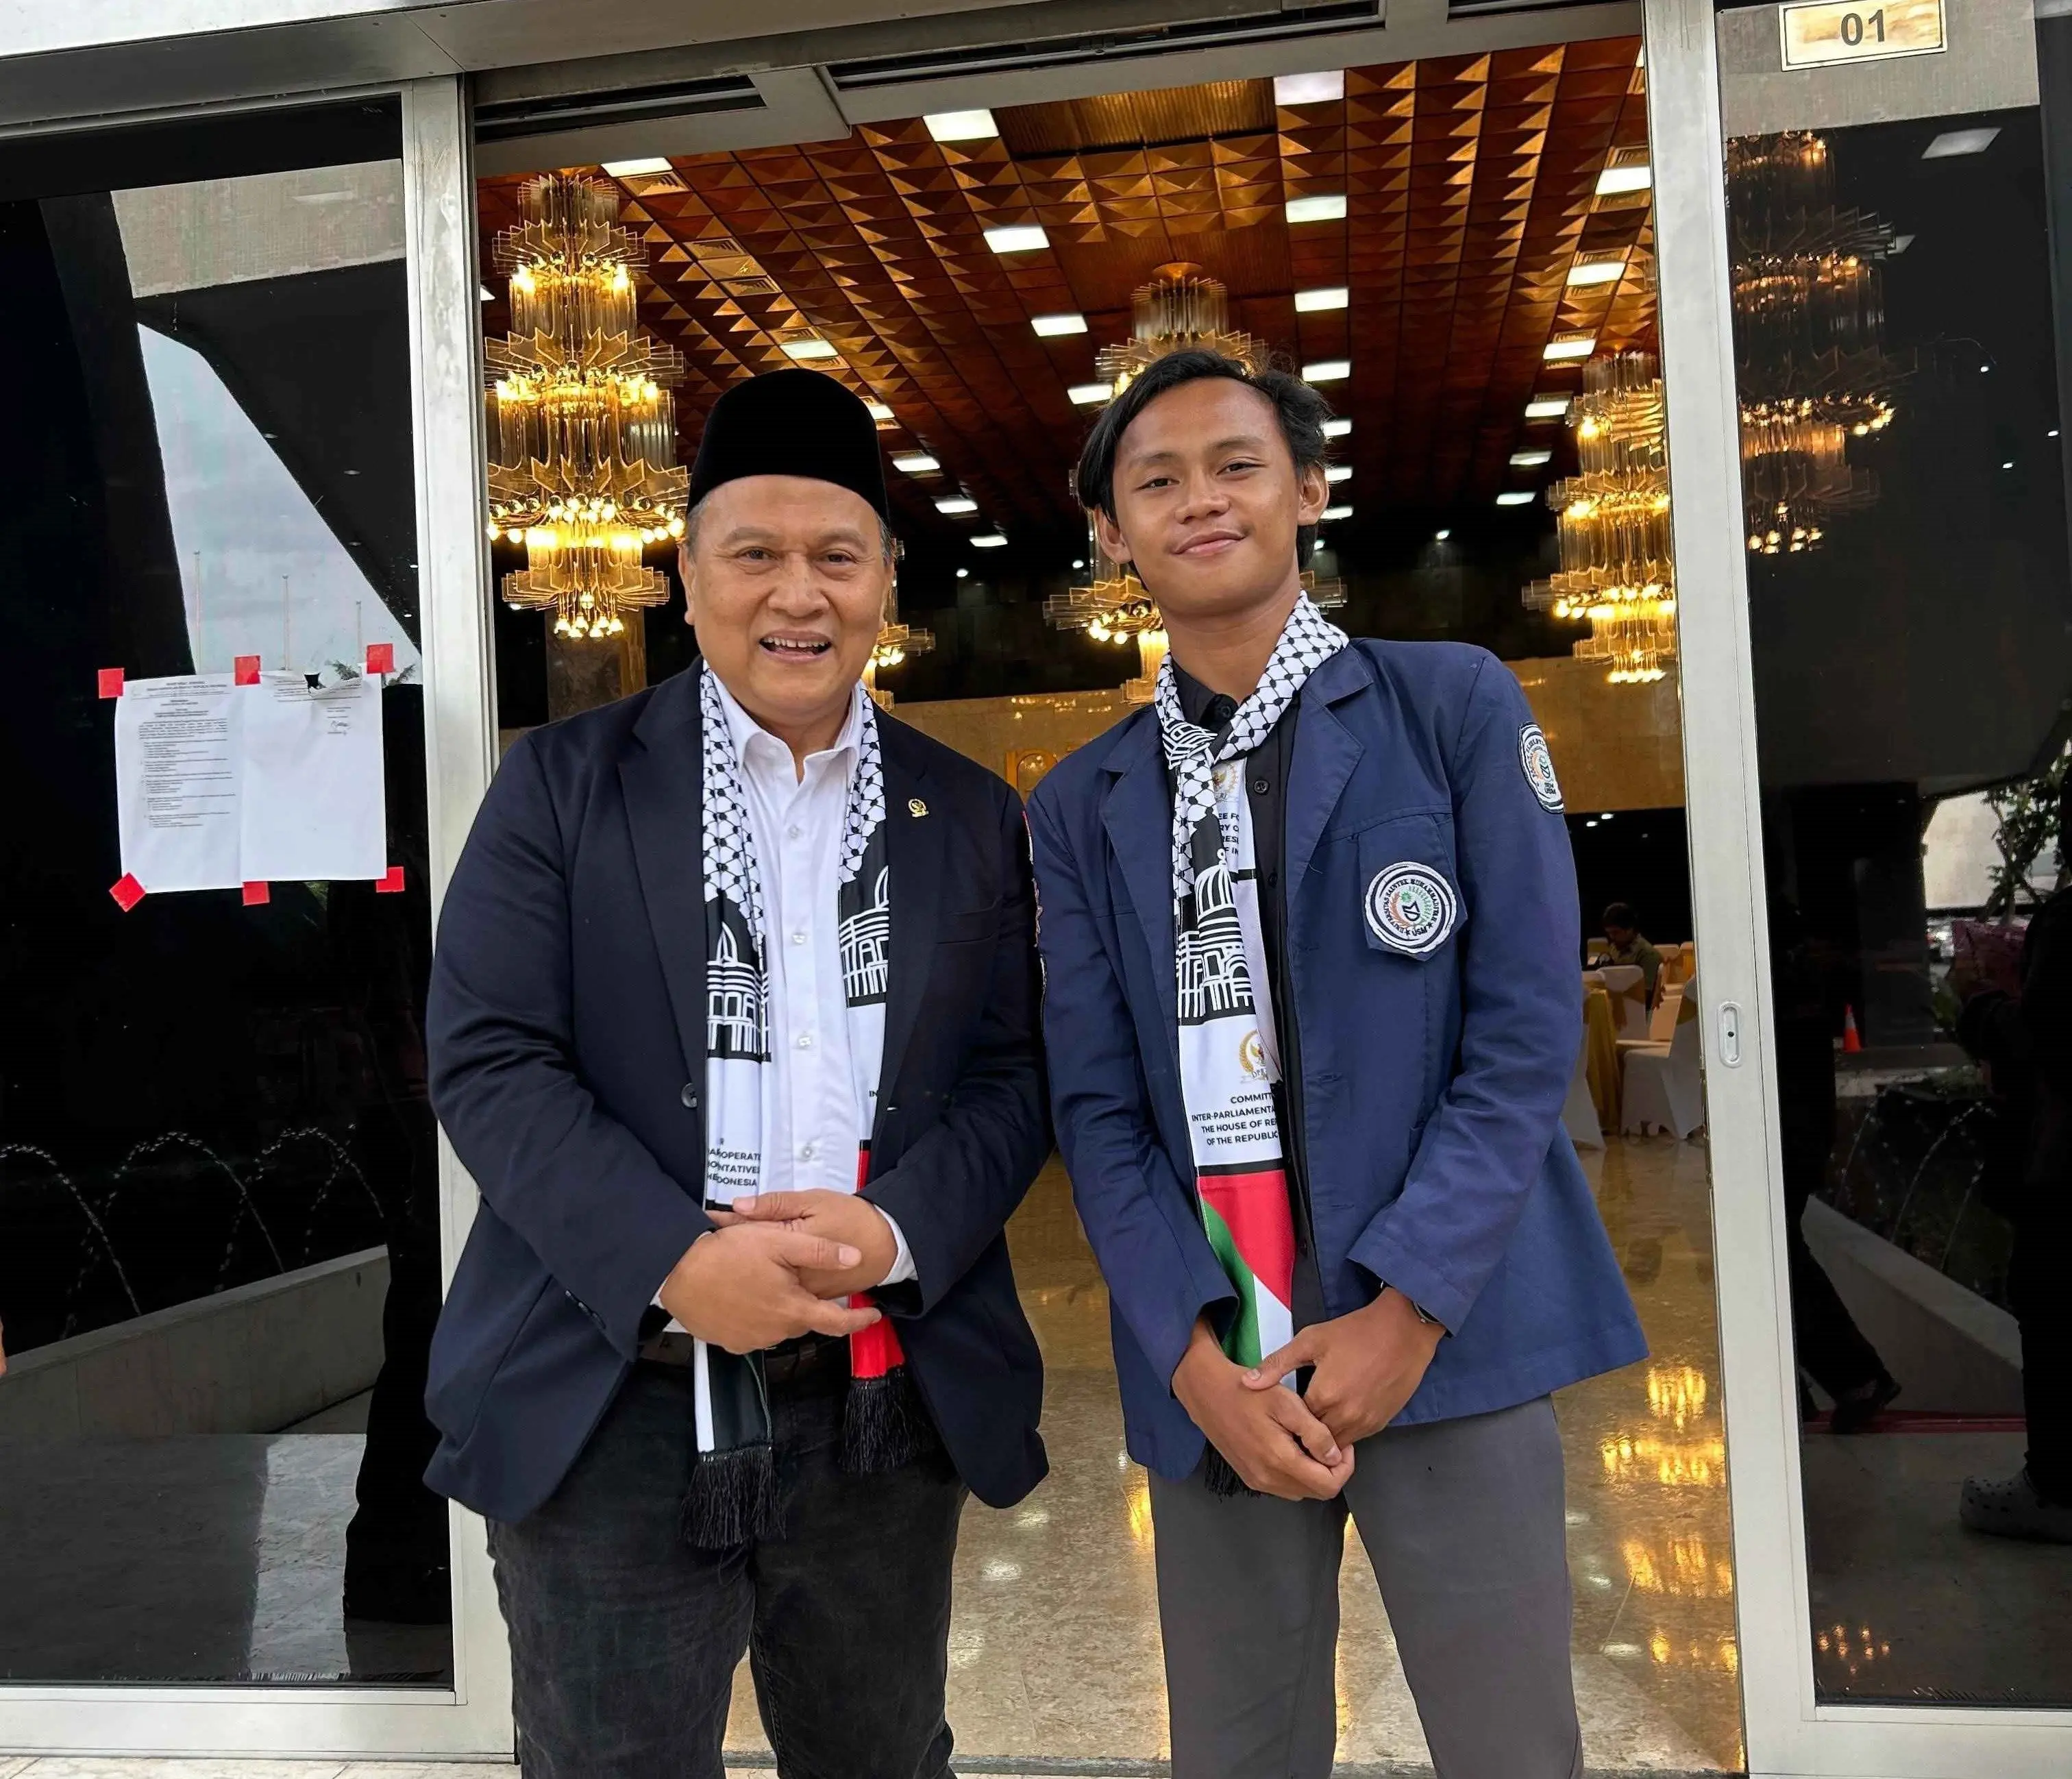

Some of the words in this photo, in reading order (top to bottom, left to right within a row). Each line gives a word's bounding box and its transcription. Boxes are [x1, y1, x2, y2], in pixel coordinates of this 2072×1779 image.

[1841, 9, 1885, 46] 01
[1201, 1125, 1215, 1133] THE
[1216, 1122, 1247, 1132] HOUSE
[1250, 1120, 1262, 1128] OF
[1216, 1136, 1233, 1144] THE
[1235, 1131, 1278, 1143] REPUBLIC
